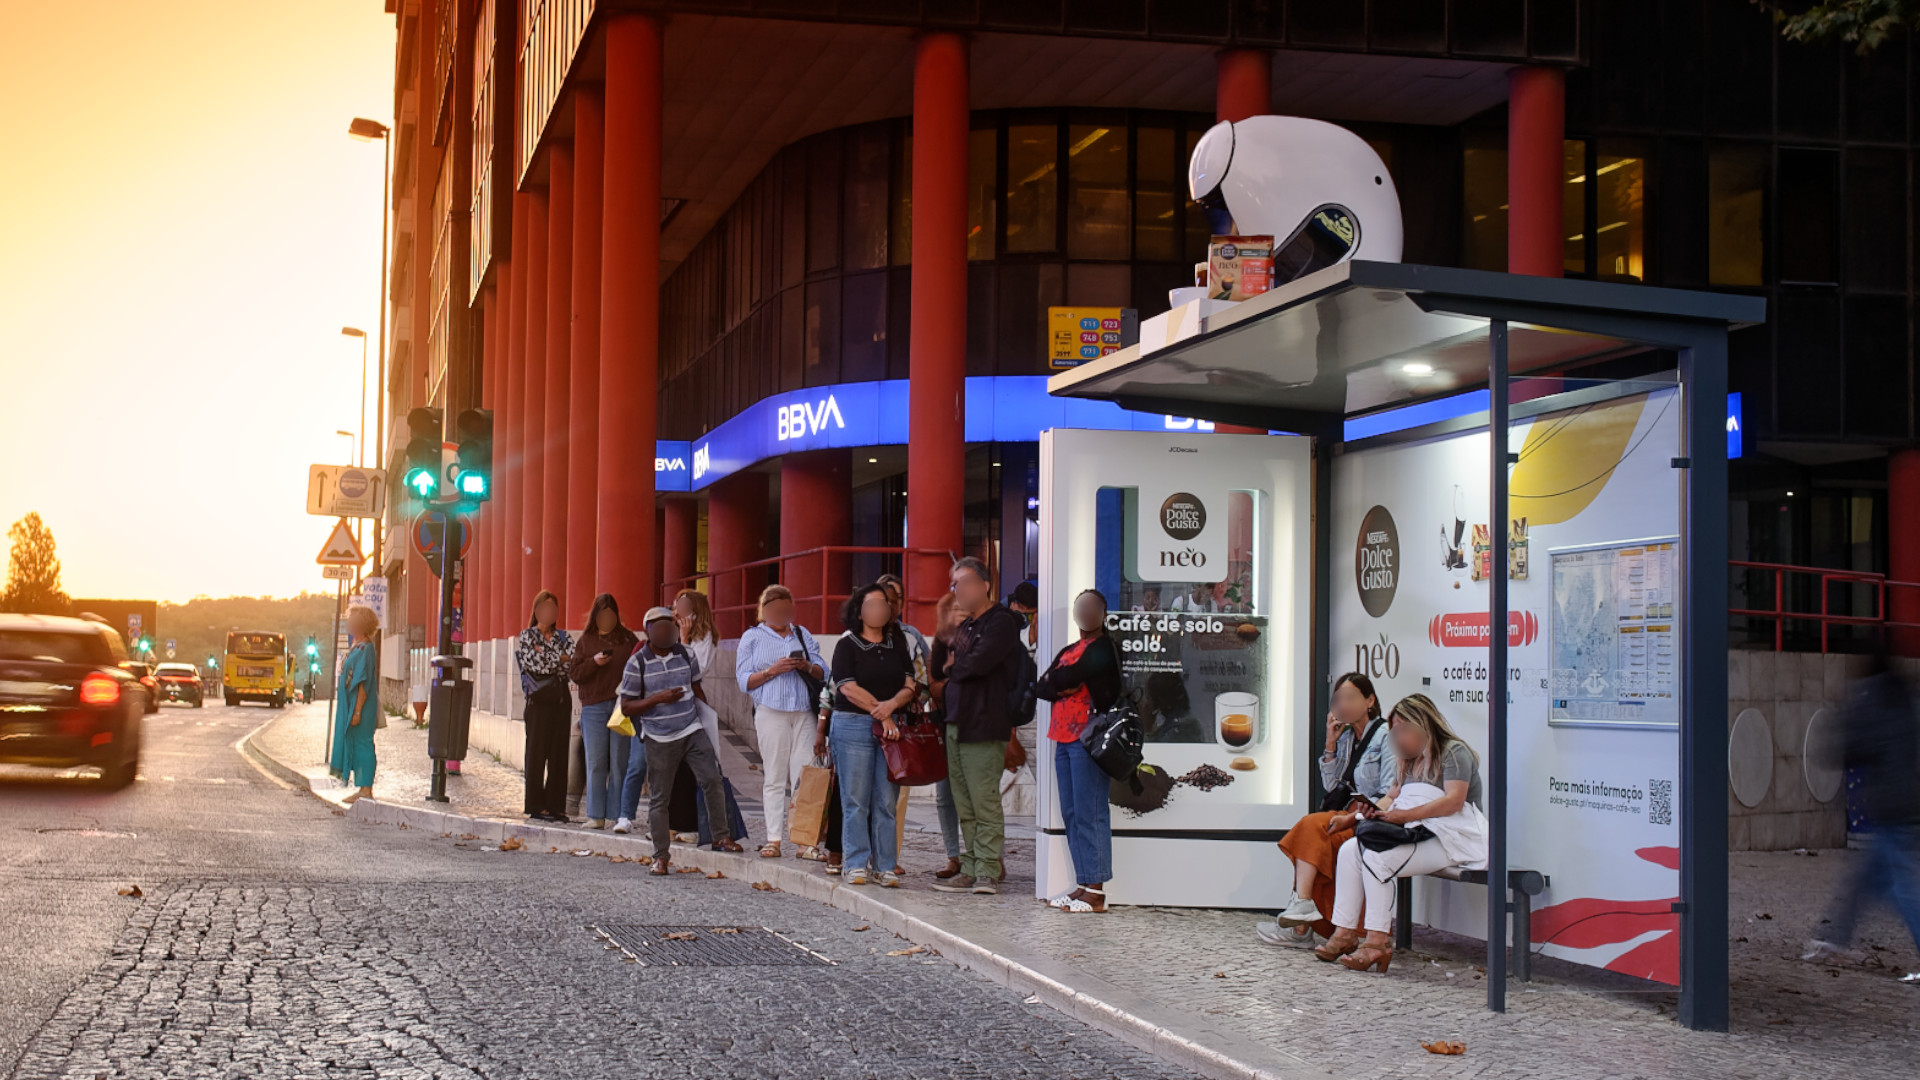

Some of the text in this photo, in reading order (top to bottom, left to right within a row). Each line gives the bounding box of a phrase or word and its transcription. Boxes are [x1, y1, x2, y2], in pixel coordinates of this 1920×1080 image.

[778, 394, 845, 441] BBVA
[693, 442, 710, 480] BBVA
[1166, 508, 1199, 520] Dolce
[1166, 518, 1200, 528] Gusto
[1360, 545, 1393, 570] Dolce
[1361, 567, 1394, 590] Gusto
[1106, 614, 1224, 633] Café de solo
[1445, 621, 1478, 637] Próxima
[1122, 634, 1166, 653] solo.
[1443, 667, 1449, 680] o
[1451, 661, 1472, 680] café
[1474, 661, 1487, 680] do
[1449, 689, 1464, 703] em
[1466, 690, 1484, 703] sua
[1549, 776, 1643, 803] Para mais informação
